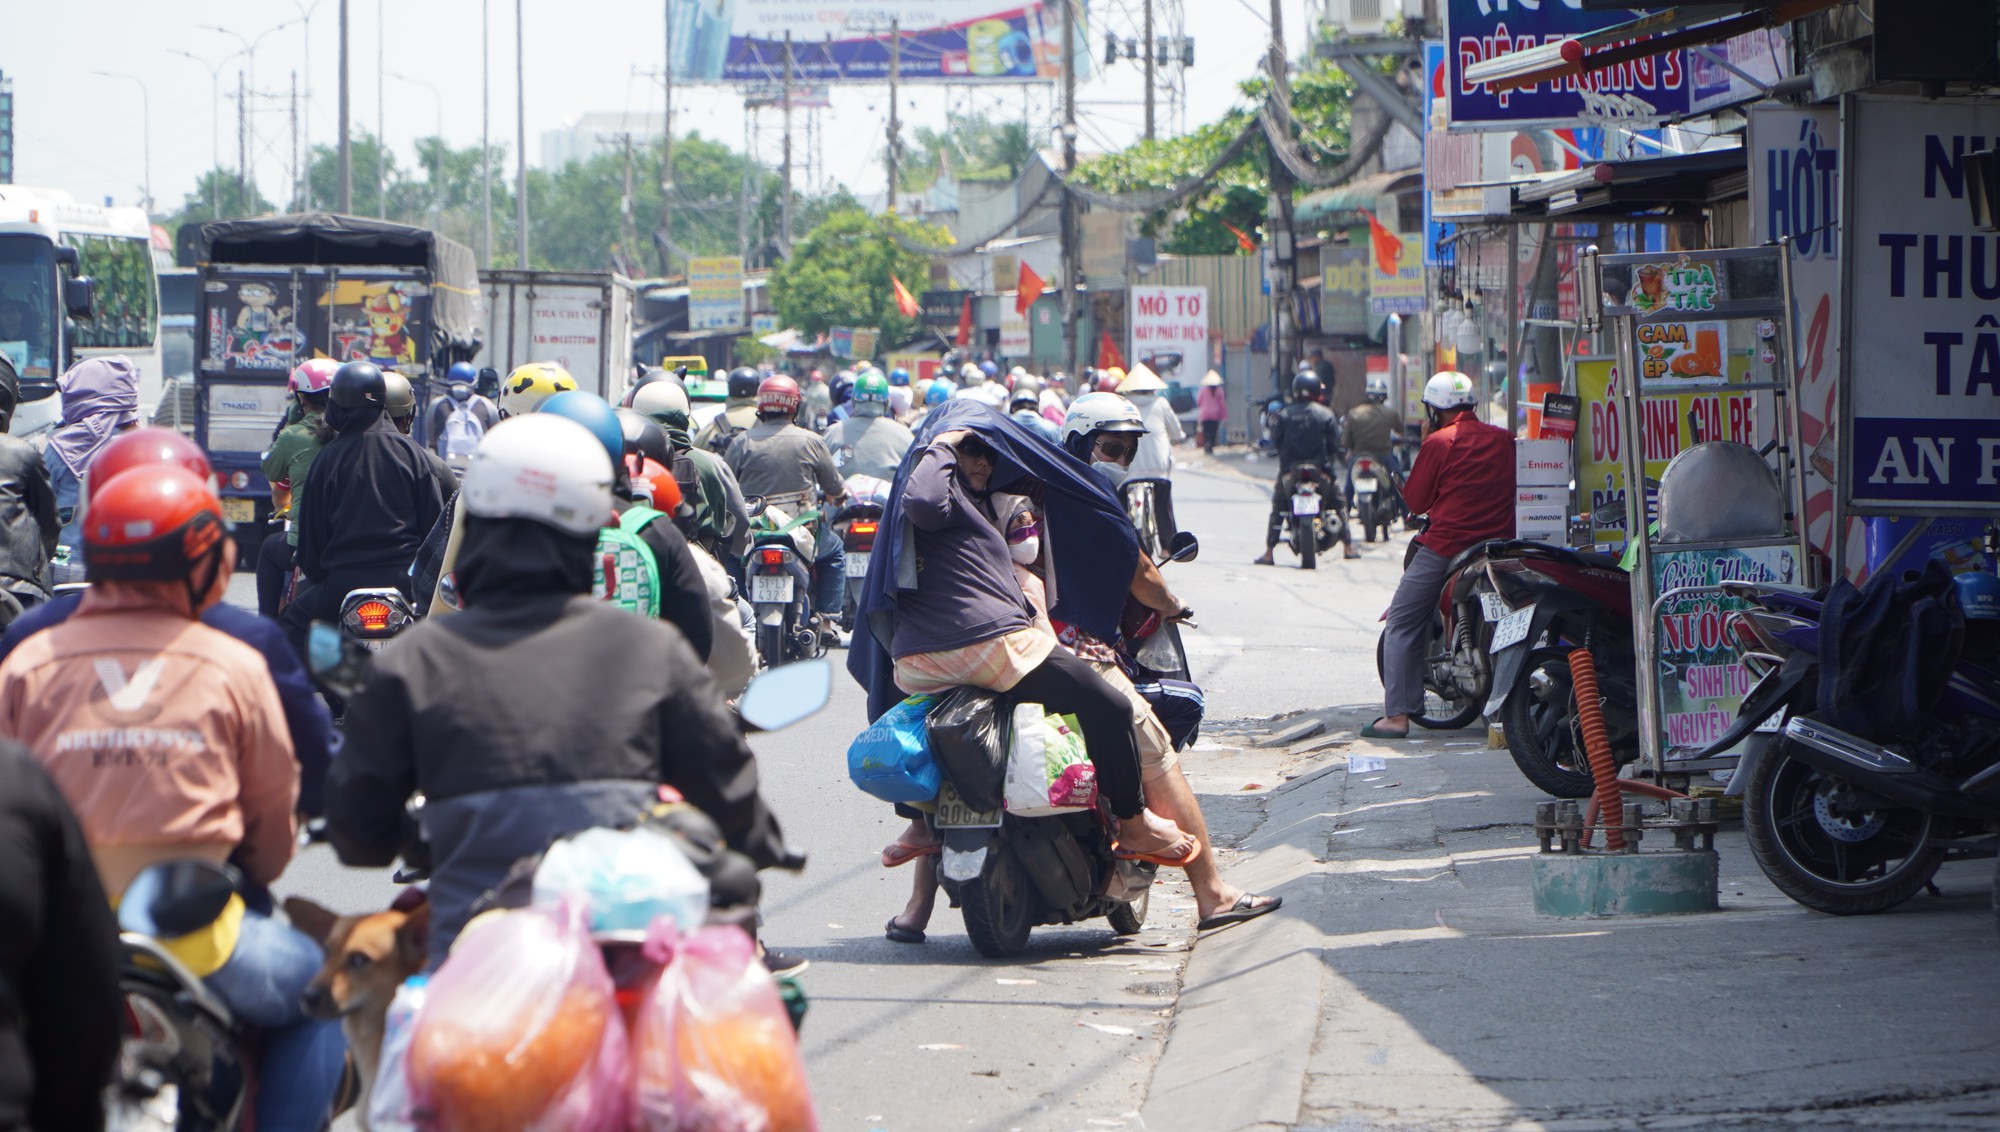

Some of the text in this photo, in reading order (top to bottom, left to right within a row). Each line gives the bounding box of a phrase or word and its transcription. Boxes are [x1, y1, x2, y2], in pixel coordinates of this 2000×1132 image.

[1767, 119, 1838, 256] HỚT
[1668, 264, 1715, 286] TRÀ
[1138, 290, 1167, 317] MÔ
[1638, 323, 1687, 344] CAM
[1643, 355, 1669, 379] ÉP
[1528, 460, 1565, 469] Enimac
[1868, 436, 1955, 484] AN
[758, 589, 787, 600] 4328
[1661, 600, 1739, 654] NƯỚC
[1686, 664, 1724, 699] SINH
[857, 726, 894, 744] CREDIT
